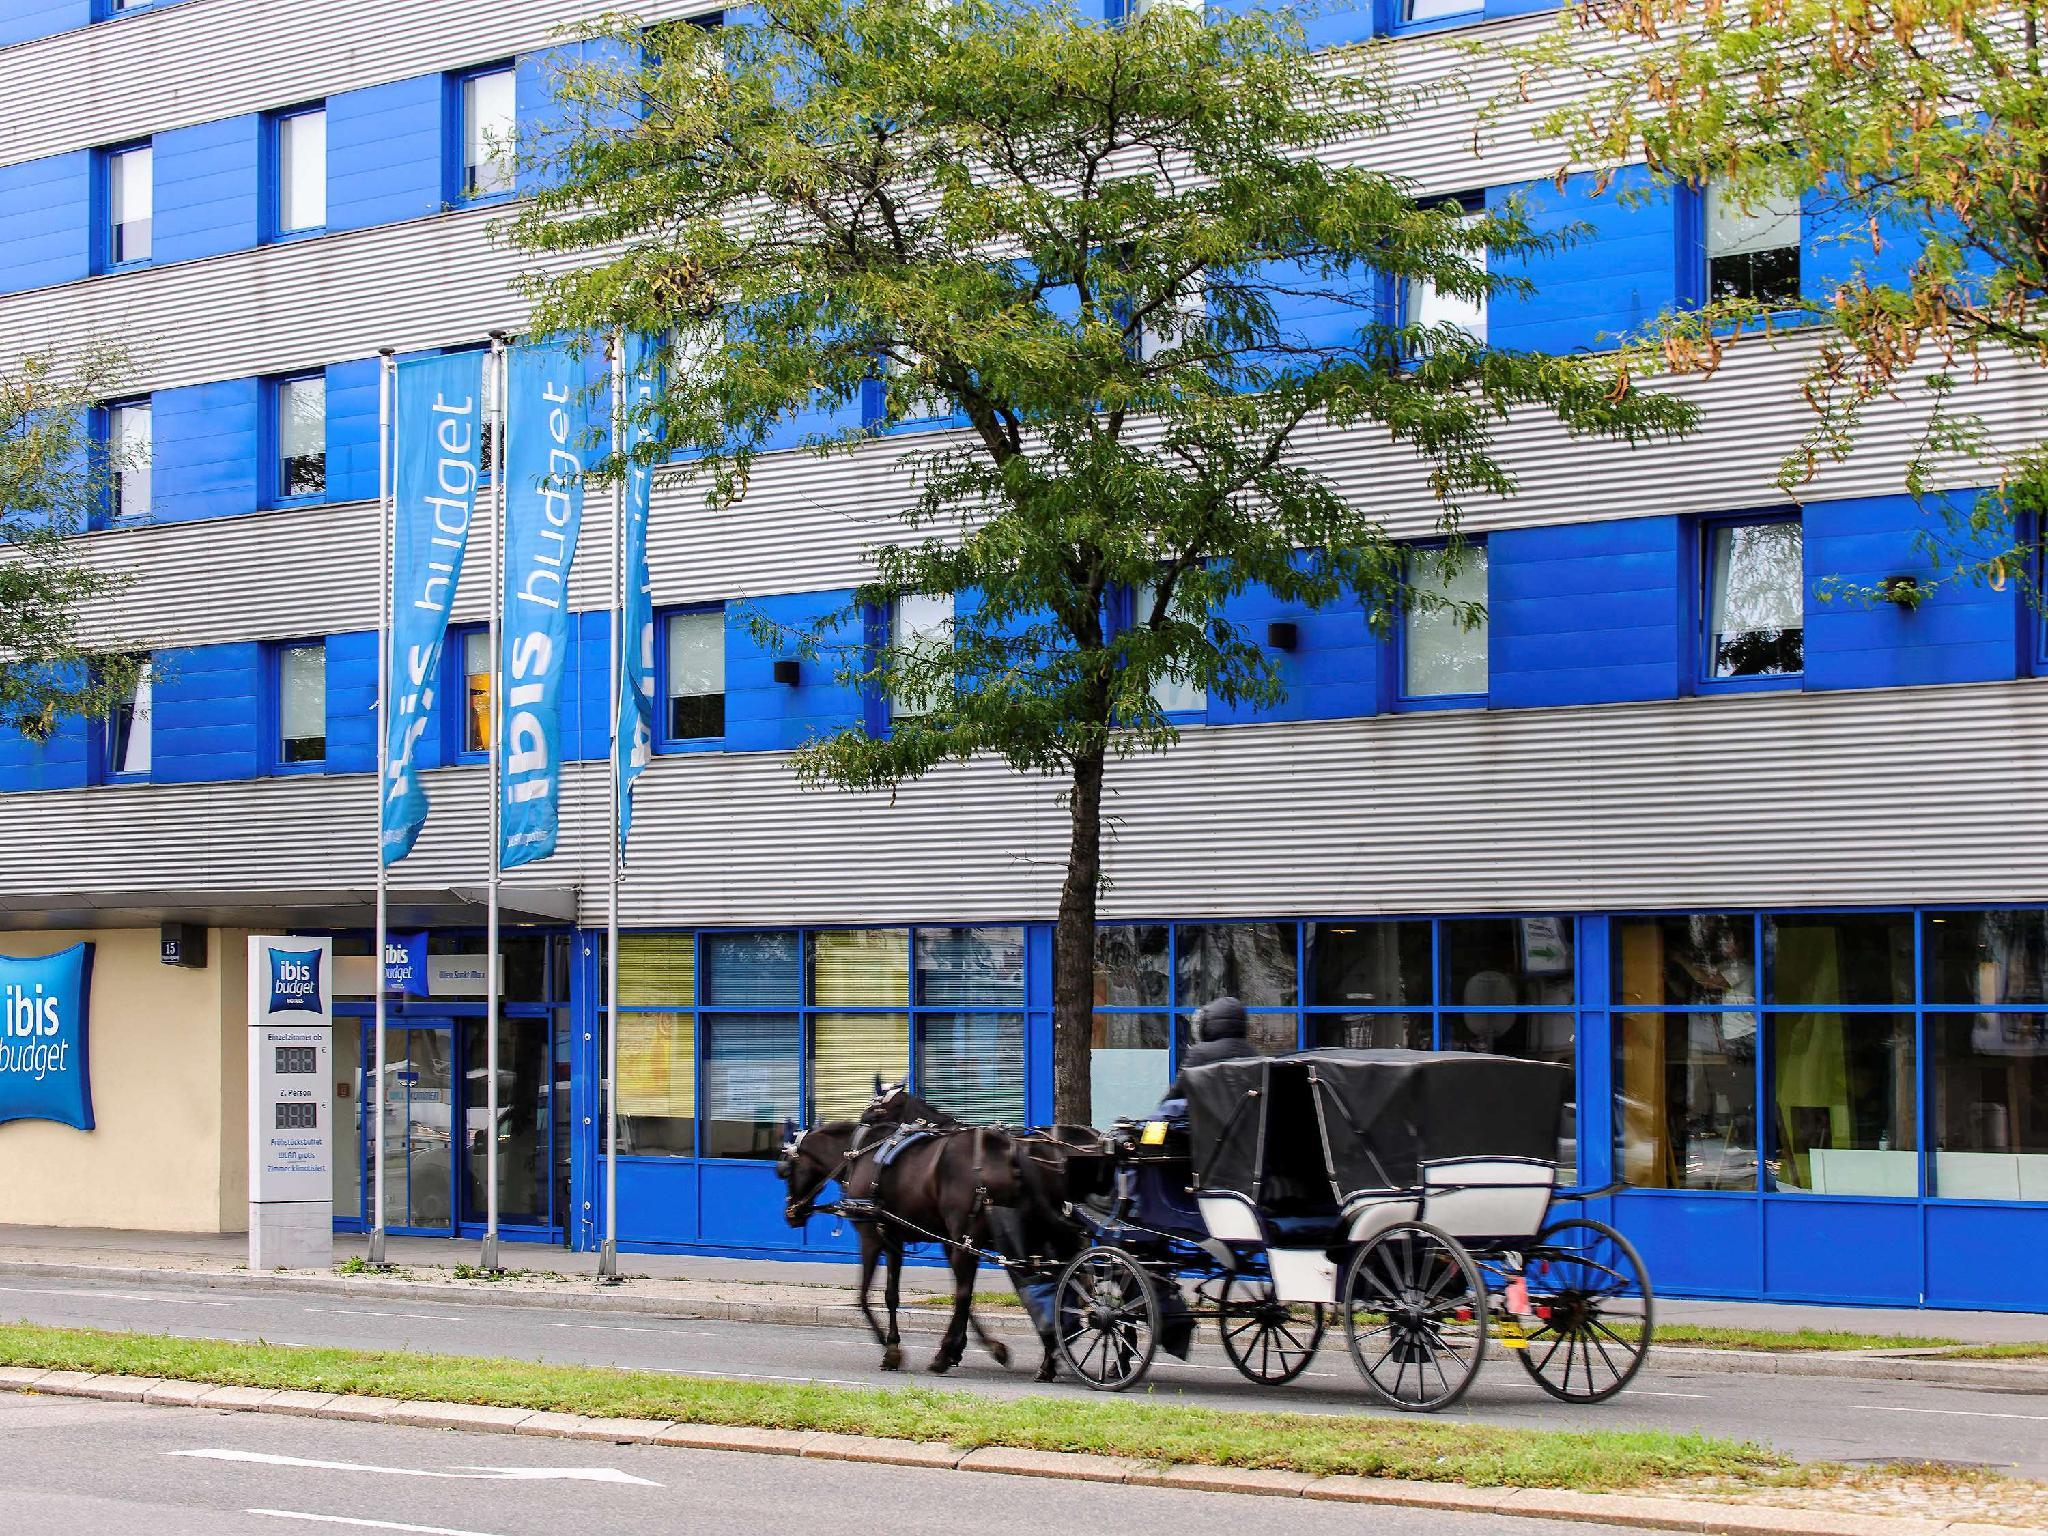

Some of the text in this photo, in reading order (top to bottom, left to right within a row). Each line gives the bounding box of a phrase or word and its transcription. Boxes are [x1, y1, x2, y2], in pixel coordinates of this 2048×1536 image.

[414, 392, 474, 611] budget
[517, 381, 582, 608] budget
[508, 631, 552, 804] ibis
[166, 942, 176, 955] 15
[385, 944, 409, 964] ibis
[280, 960, 310, 981] ibis
[275, 979, 315, 997] budget
[6, 983, 60, 1037] ibis
[0, 1035, 69, 1081] budget
[289, 1089, 312, 1097] Person
